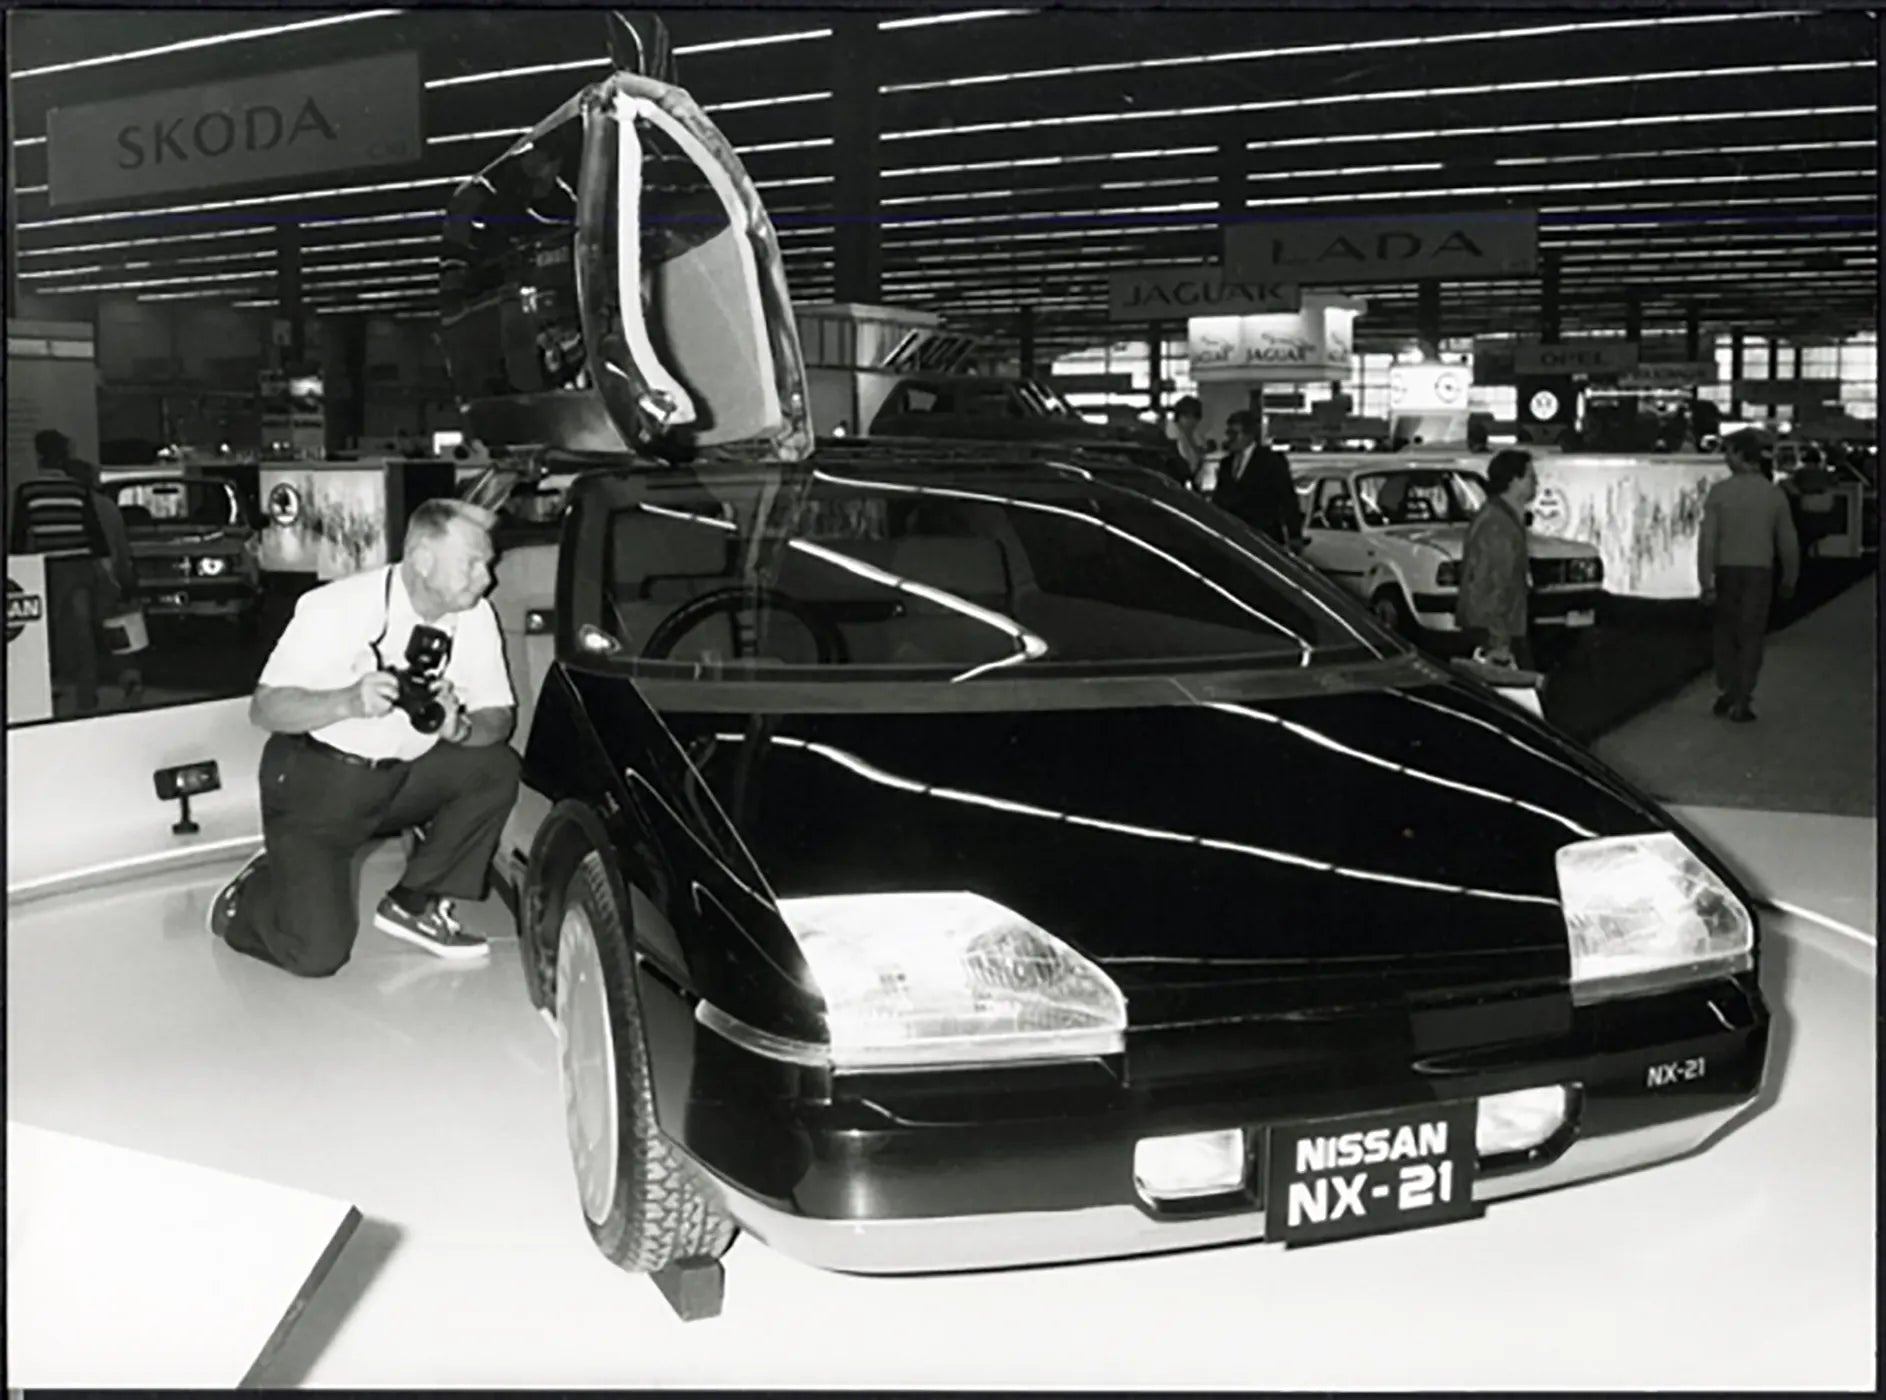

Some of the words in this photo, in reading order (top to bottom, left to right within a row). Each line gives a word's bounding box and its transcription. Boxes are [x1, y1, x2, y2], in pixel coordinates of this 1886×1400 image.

[117, 96, 337, 169] SKODA
[1271, 230, 1483, 265] LADA
[1646, 1057, 1706, 1087] NX-21
[1295, 1121, 1449, 1173] NISSAN
[1288, 1161, 1454, 1227] NX-21
